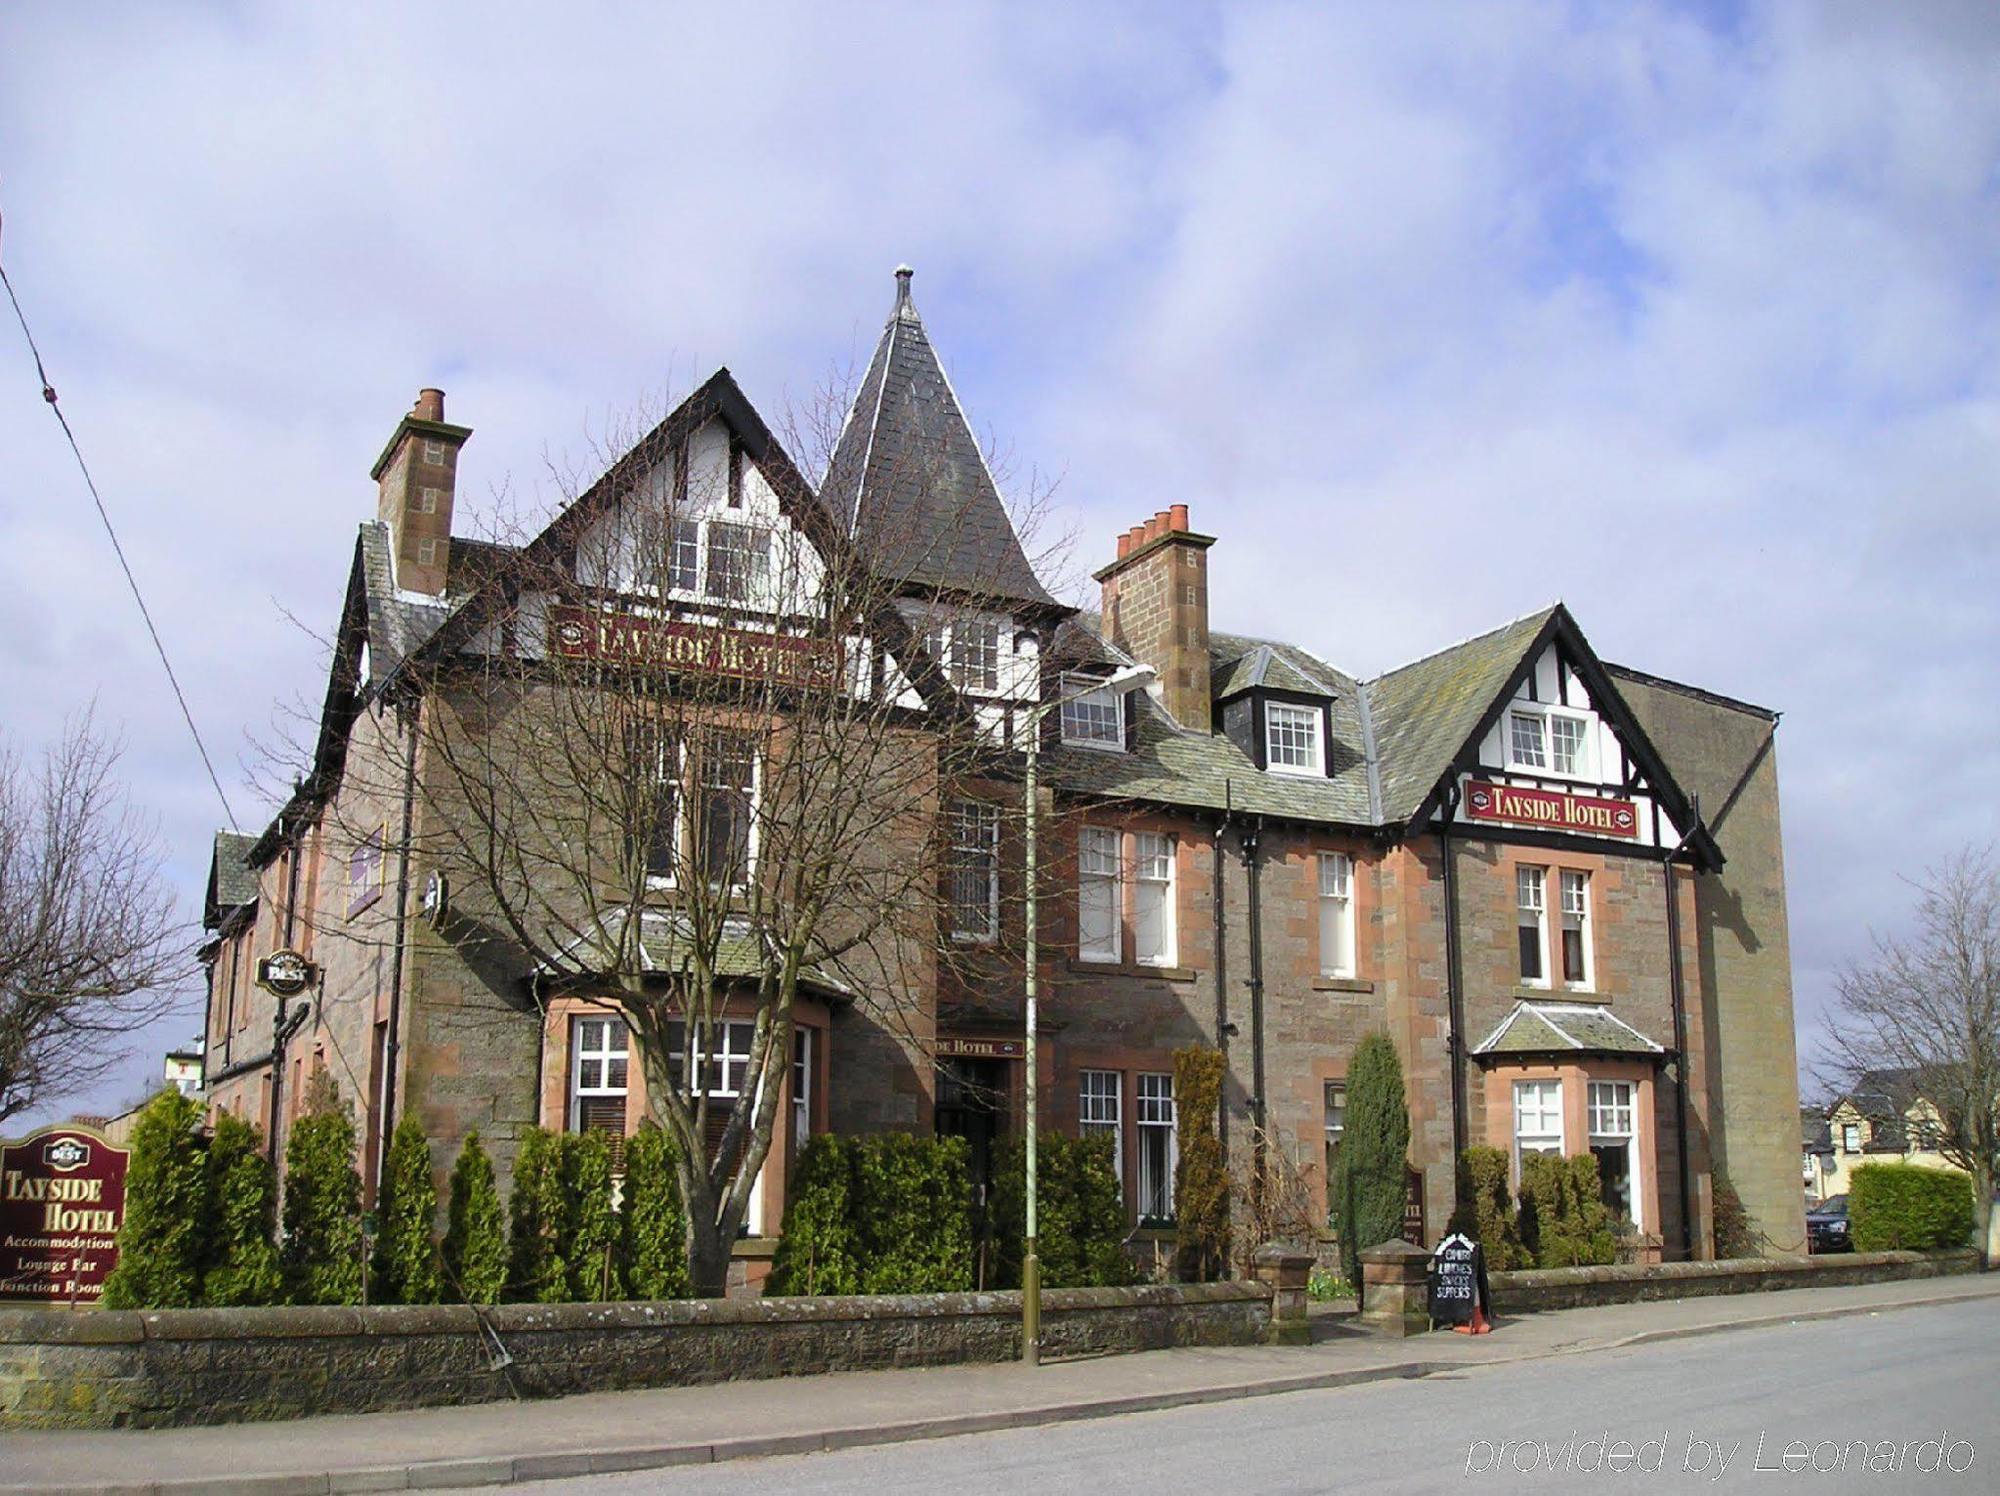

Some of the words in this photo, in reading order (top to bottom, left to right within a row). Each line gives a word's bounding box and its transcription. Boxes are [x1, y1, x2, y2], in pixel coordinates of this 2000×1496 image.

[600, 618, 711, 666] TAYIDE
[1492, 788, 1561, 823] TAYSIDE
[1564, 797, 1615, 829] HOTEL
[954, 1040, 997, 1054] HOTEL
[6, 1170, 103, 1201] TAYSIDE
[43, 1203, 119, 1232] HOTEL
[17, 1257, 68, 1274] Lounge
[71, 1258, 98, 1272] Bar
